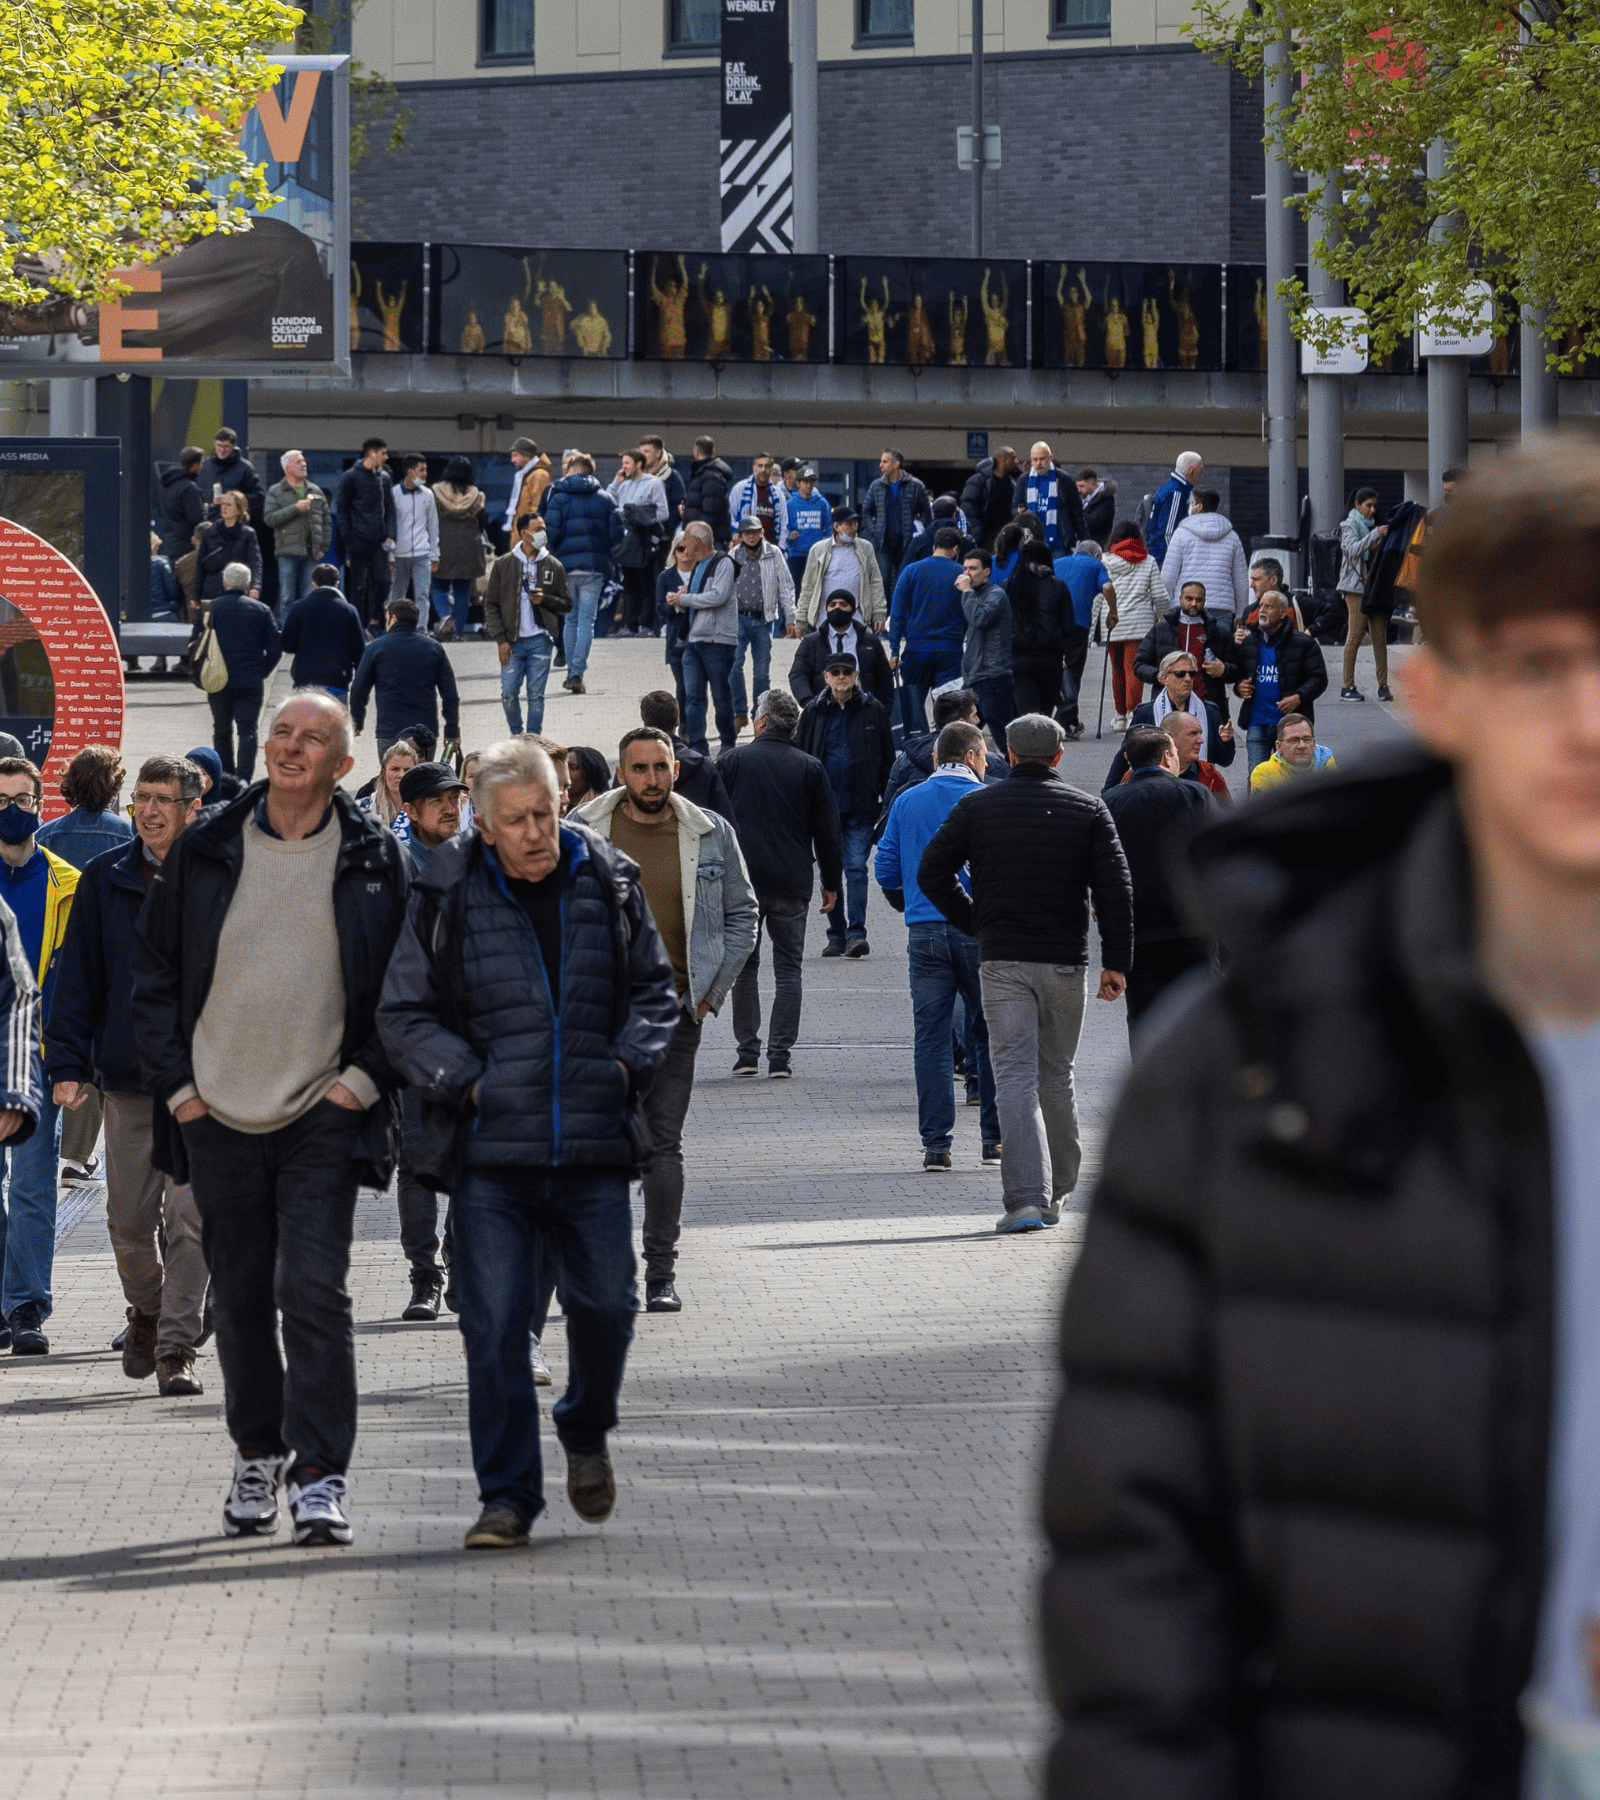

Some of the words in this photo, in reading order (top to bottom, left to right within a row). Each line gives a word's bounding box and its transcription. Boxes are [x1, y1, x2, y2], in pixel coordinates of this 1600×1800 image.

[726, 0, 775, 12] WEMBLEY
[725, 62, 746, 75] EAT.
[726, 75, 761, 89] DRINK.
[726, 90, 753, 103] PLAY.
[99, 270, 162, 361] E
[271, 316, 316, 326] LONDON
[272, 325, 322, 335] DESIGNER
[271, 334, 310, 343] OUTLET
[19, 451, 50, 461] MEDIA
